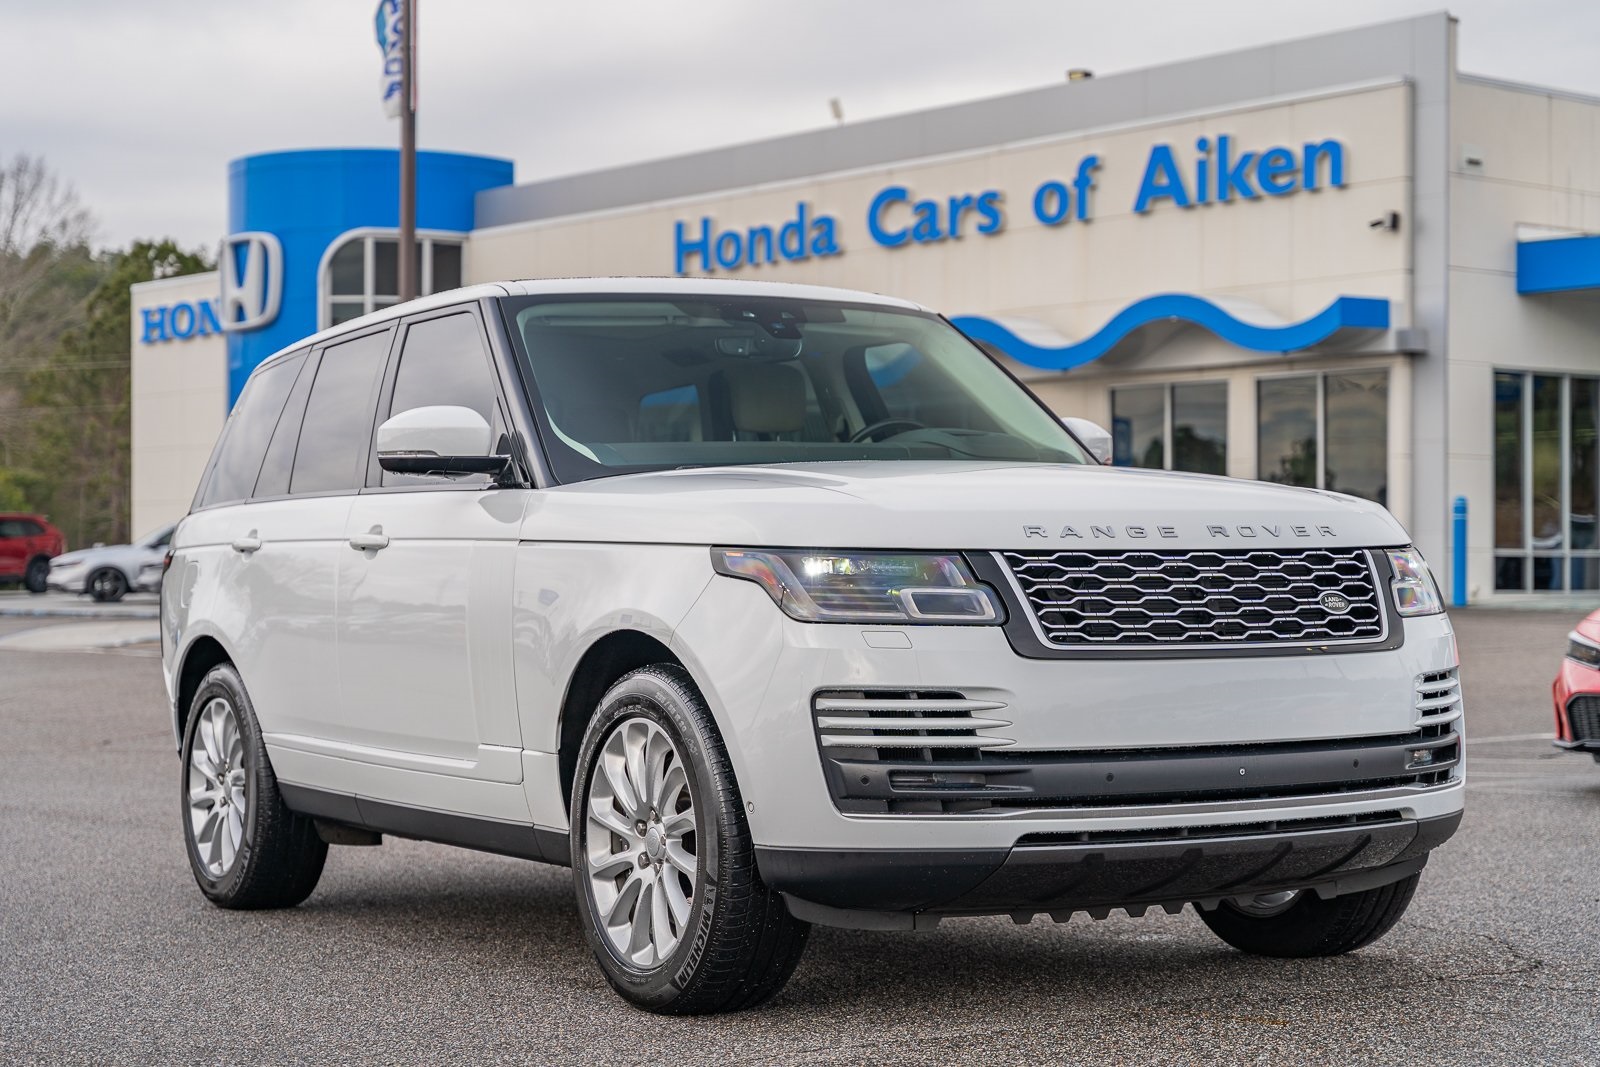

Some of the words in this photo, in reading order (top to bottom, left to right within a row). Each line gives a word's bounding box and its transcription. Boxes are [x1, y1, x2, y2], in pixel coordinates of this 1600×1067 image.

[674, 202, 839, 275] Honda
[866, 186, 1004, 249] Cars
[1032, 154, 1100, 225] of
[1134, 134, 1345, 214] Aiken
[1022, 525, 1179, 539] RANGE
[1206, 525, 1338, 538] ROVER
[677, 909, 712, 987] MICHELIN
